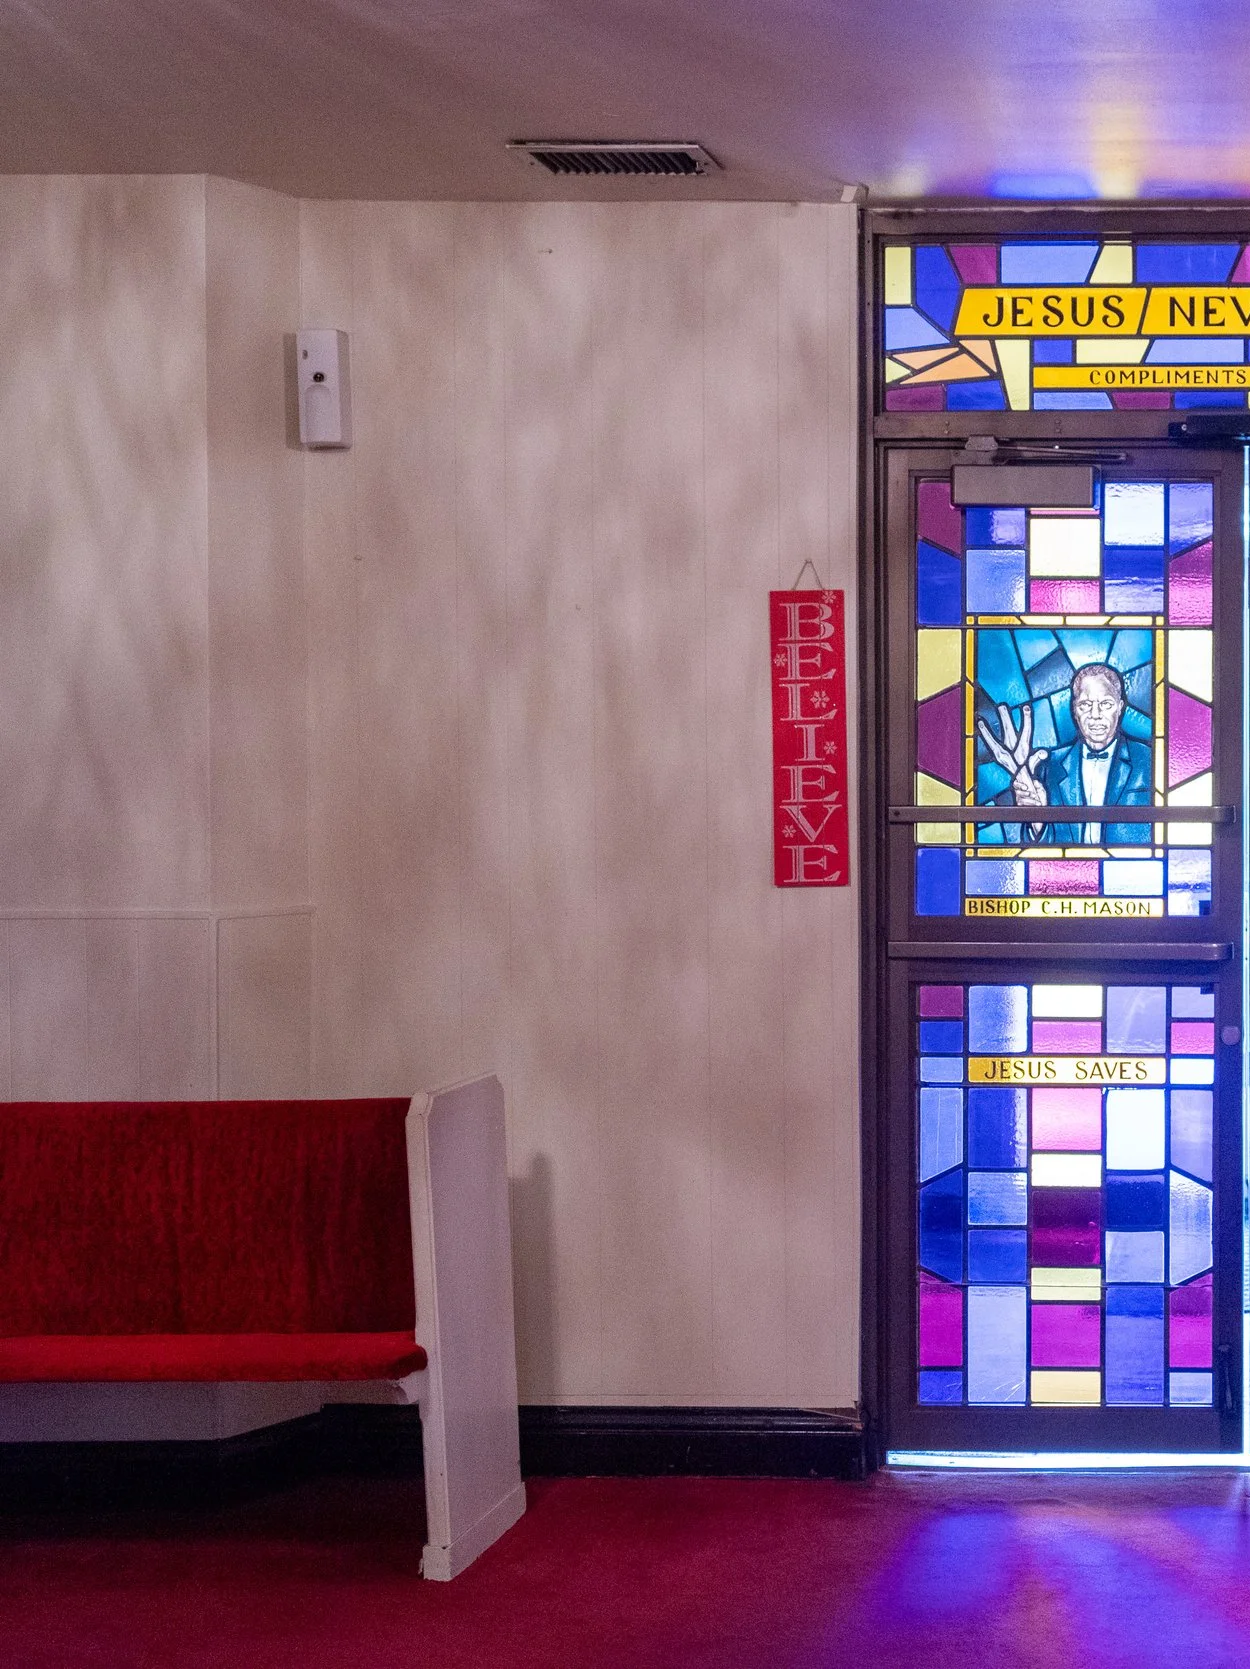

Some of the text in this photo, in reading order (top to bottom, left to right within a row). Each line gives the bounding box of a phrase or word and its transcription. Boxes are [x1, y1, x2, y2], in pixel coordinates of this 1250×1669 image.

[982, 294, 1126, 328] JESUS
[1089, 369, 1248, 386] COMPLIMENTS
[777, 601, 843, 884] BELIEVE
[967, 899, 1031, 915] BISHOP
[984, 1060, 1149, 1081] JESUS SAVES
